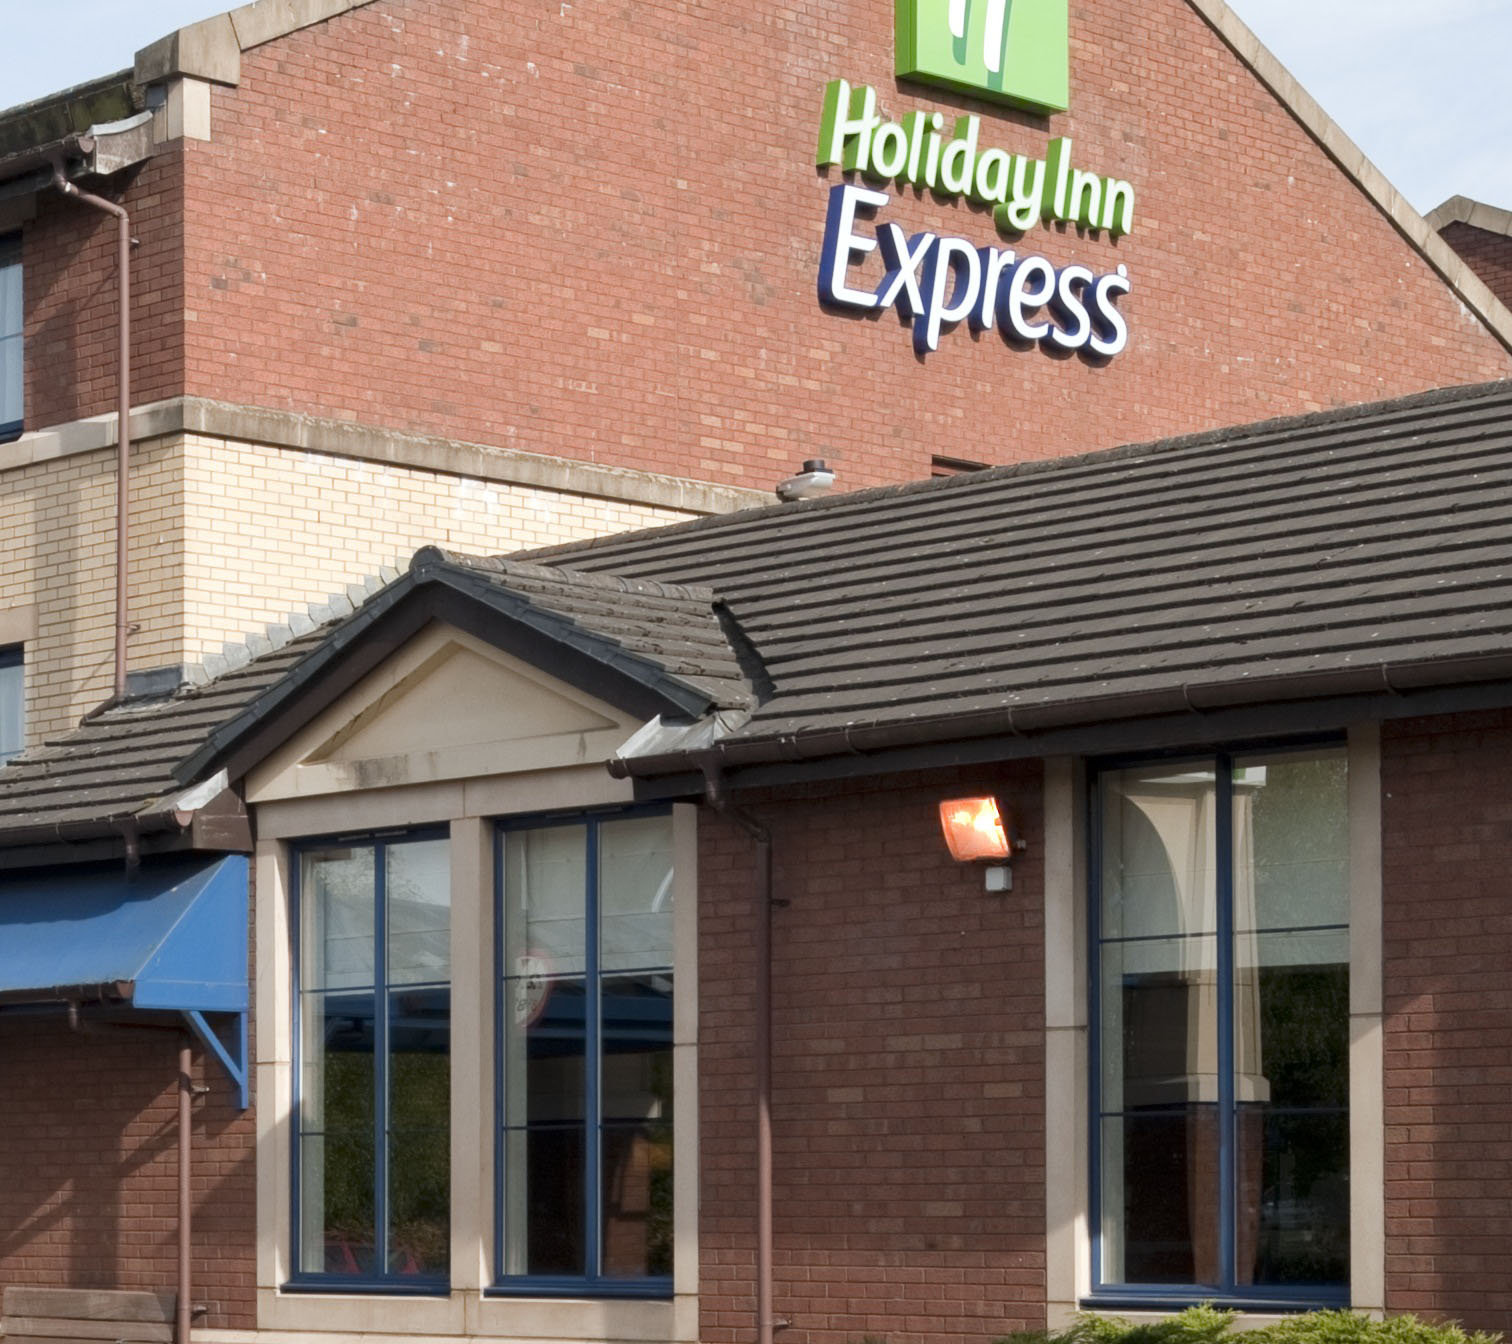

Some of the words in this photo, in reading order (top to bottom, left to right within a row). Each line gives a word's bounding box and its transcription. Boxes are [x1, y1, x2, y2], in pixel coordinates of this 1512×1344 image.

[819, 78, 1046, 233] Holiday
[1044, 136, 1135, 236] Inn
[820, 183, 1131, 357] Express
